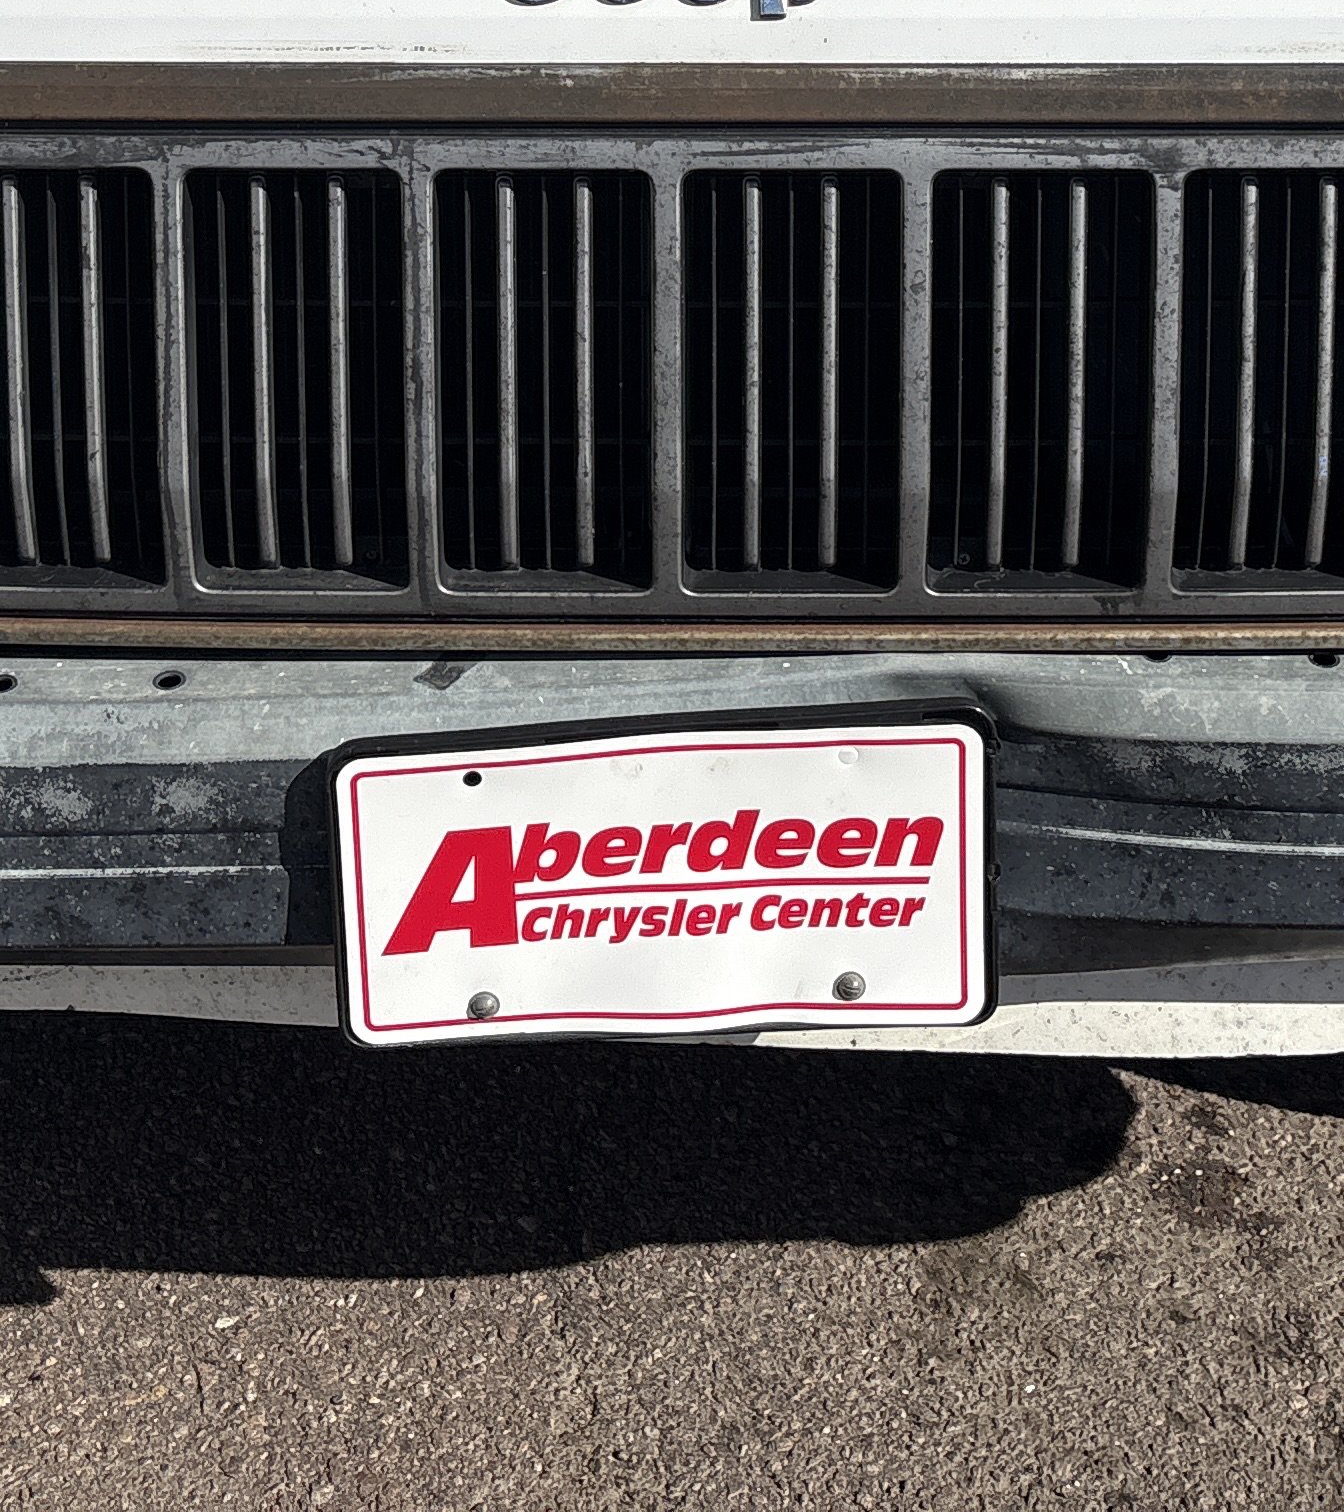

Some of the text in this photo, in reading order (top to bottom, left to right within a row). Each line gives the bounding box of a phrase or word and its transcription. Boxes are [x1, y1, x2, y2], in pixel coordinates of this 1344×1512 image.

[380, 808, 945, 957] Aberdeen
[521, 891, 926, 944] Chrysler Center
